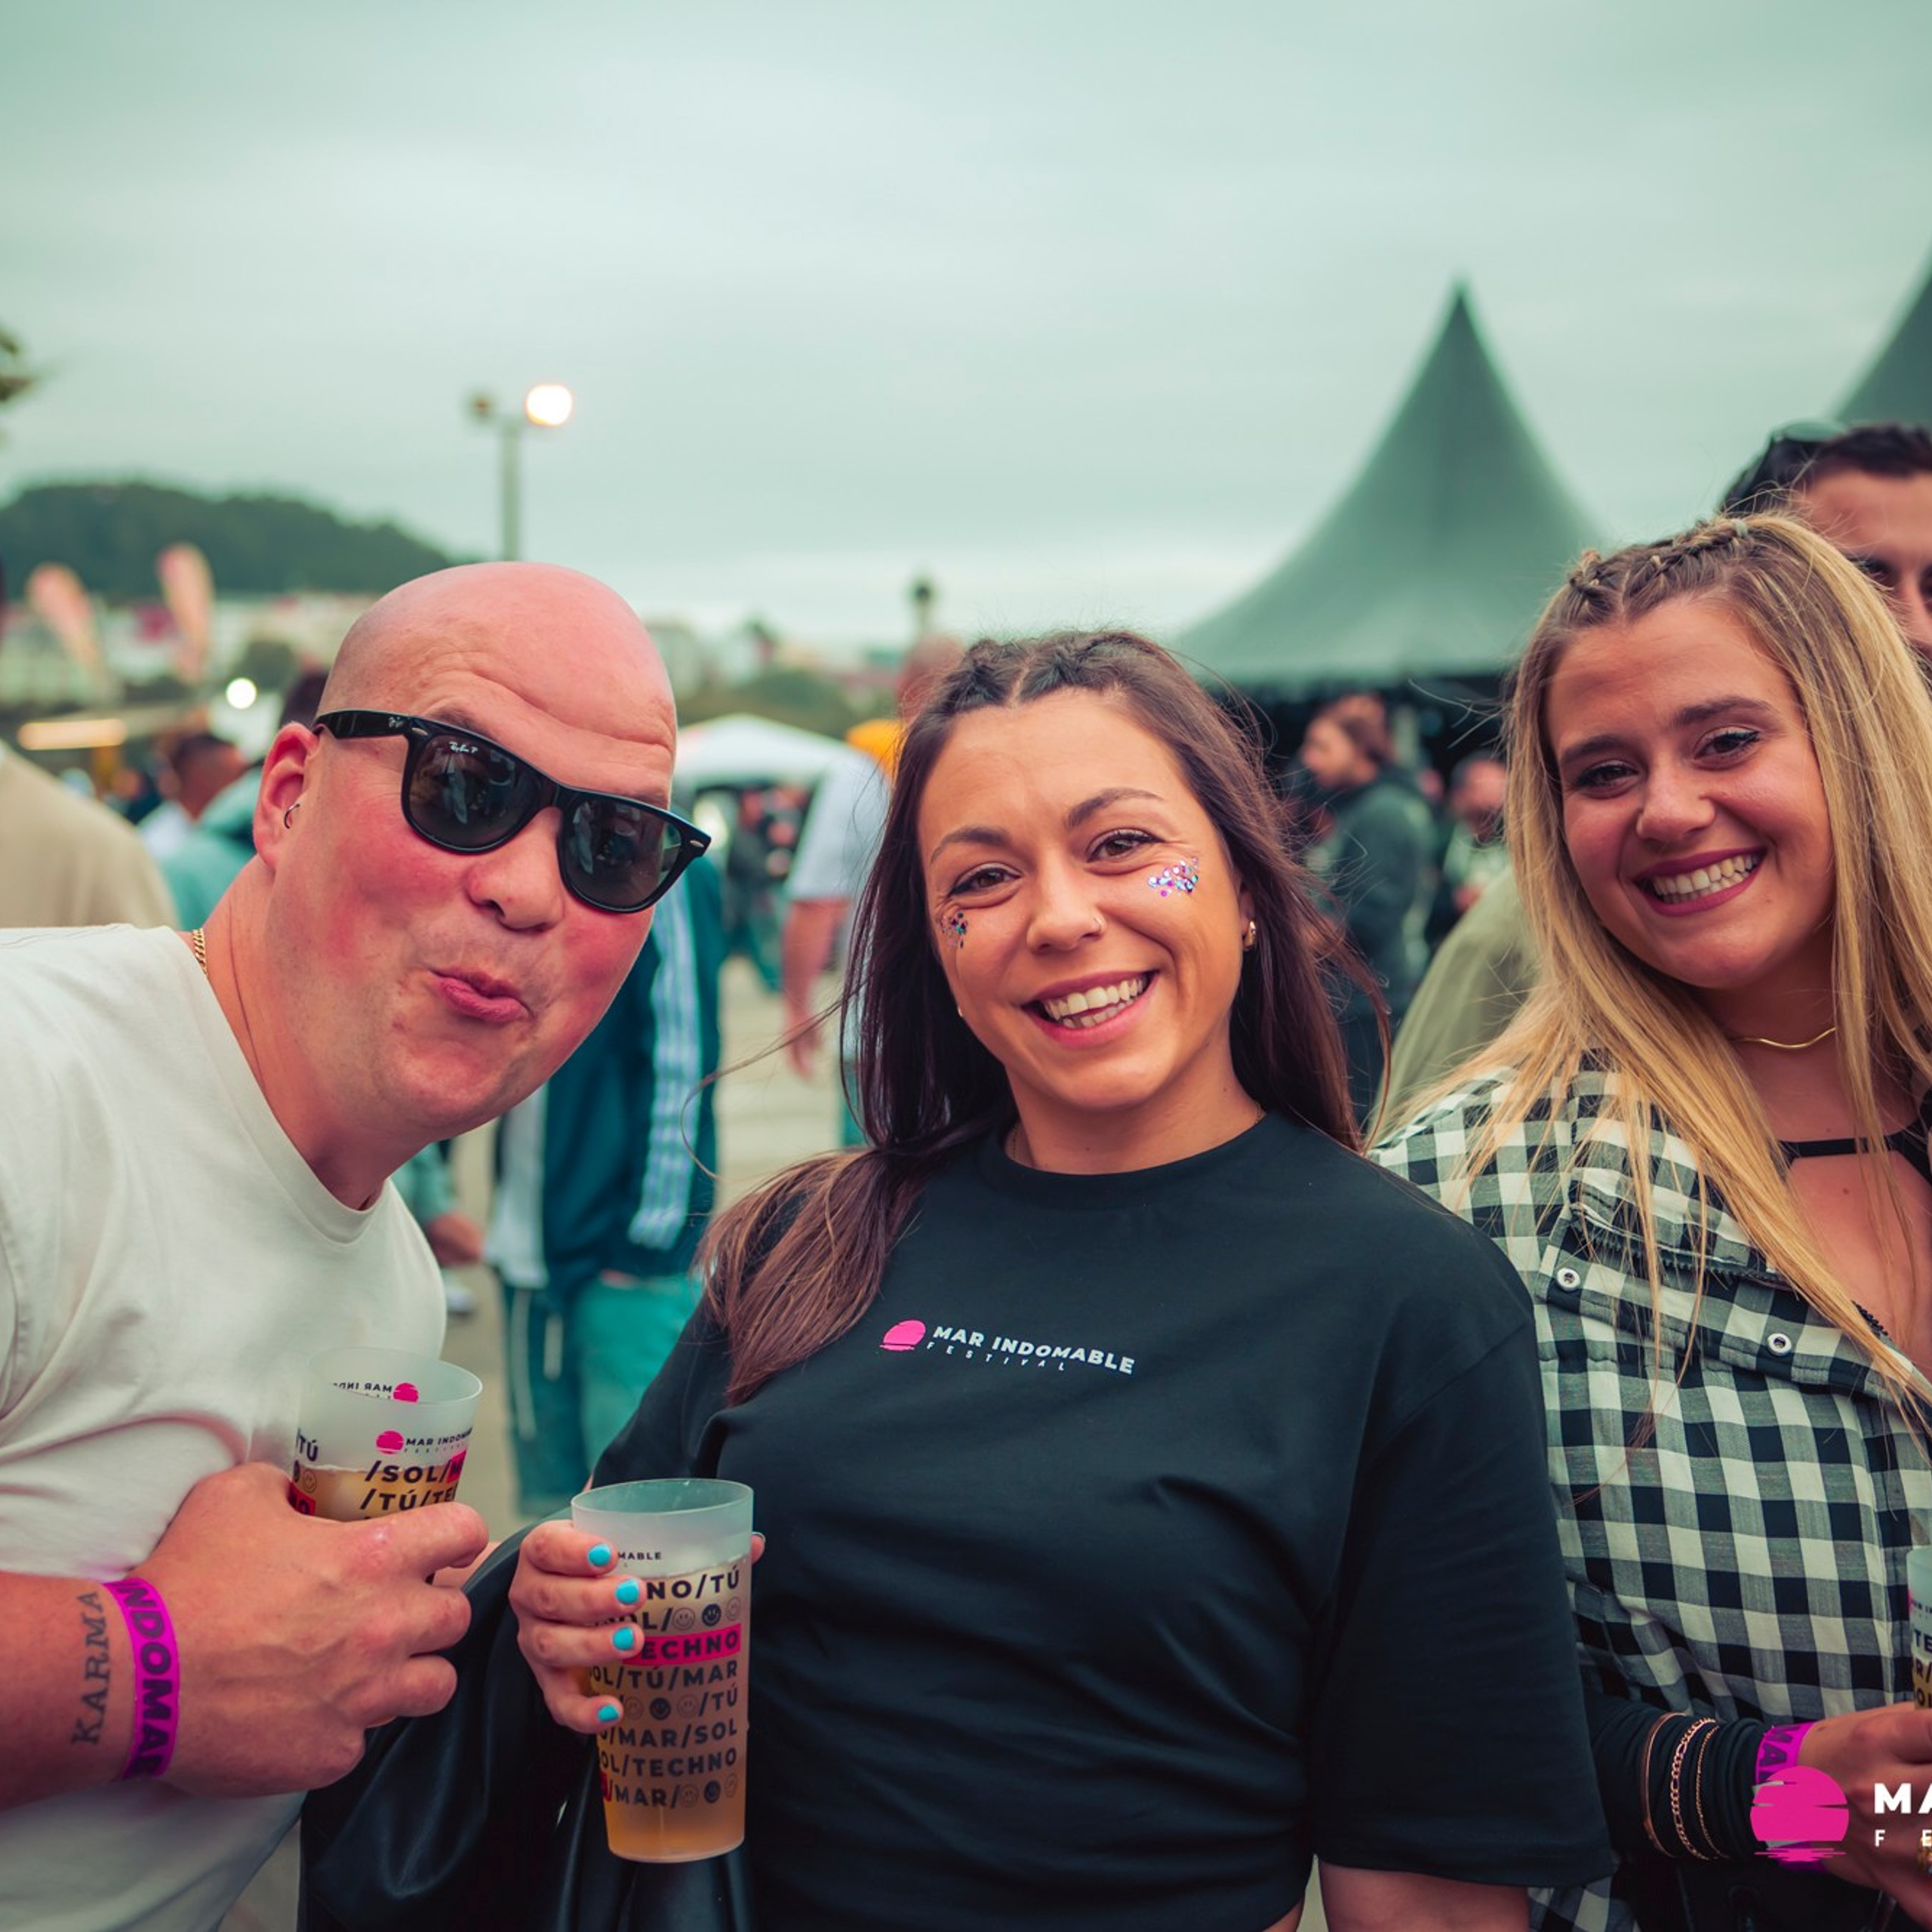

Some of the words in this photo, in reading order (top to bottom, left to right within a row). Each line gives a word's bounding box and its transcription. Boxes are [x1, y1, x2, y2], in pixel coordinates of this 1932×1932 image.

[927, 1342, 1064, 1371] FESTIVAL
[933, 1326, 984, 1347] MAR
[992, 1337, 1135, 1374] INDOMABLE
[360, 1485, 457, 1510] /TÚ/TE
[618, 1552, 662, 1560] MABLE
[647, 1565, 740, 1599] NO/TÚ
[641, 1631, 739, 1660] ECHNO
[71, 1591, 111, 1746] KARMA
[591, 1660, 737, 1690] OL/TÚ/MAR
[601, 1747, 737, 1777] OL/TECHNO
[608, 1780, 681, 1809] /MAR/
